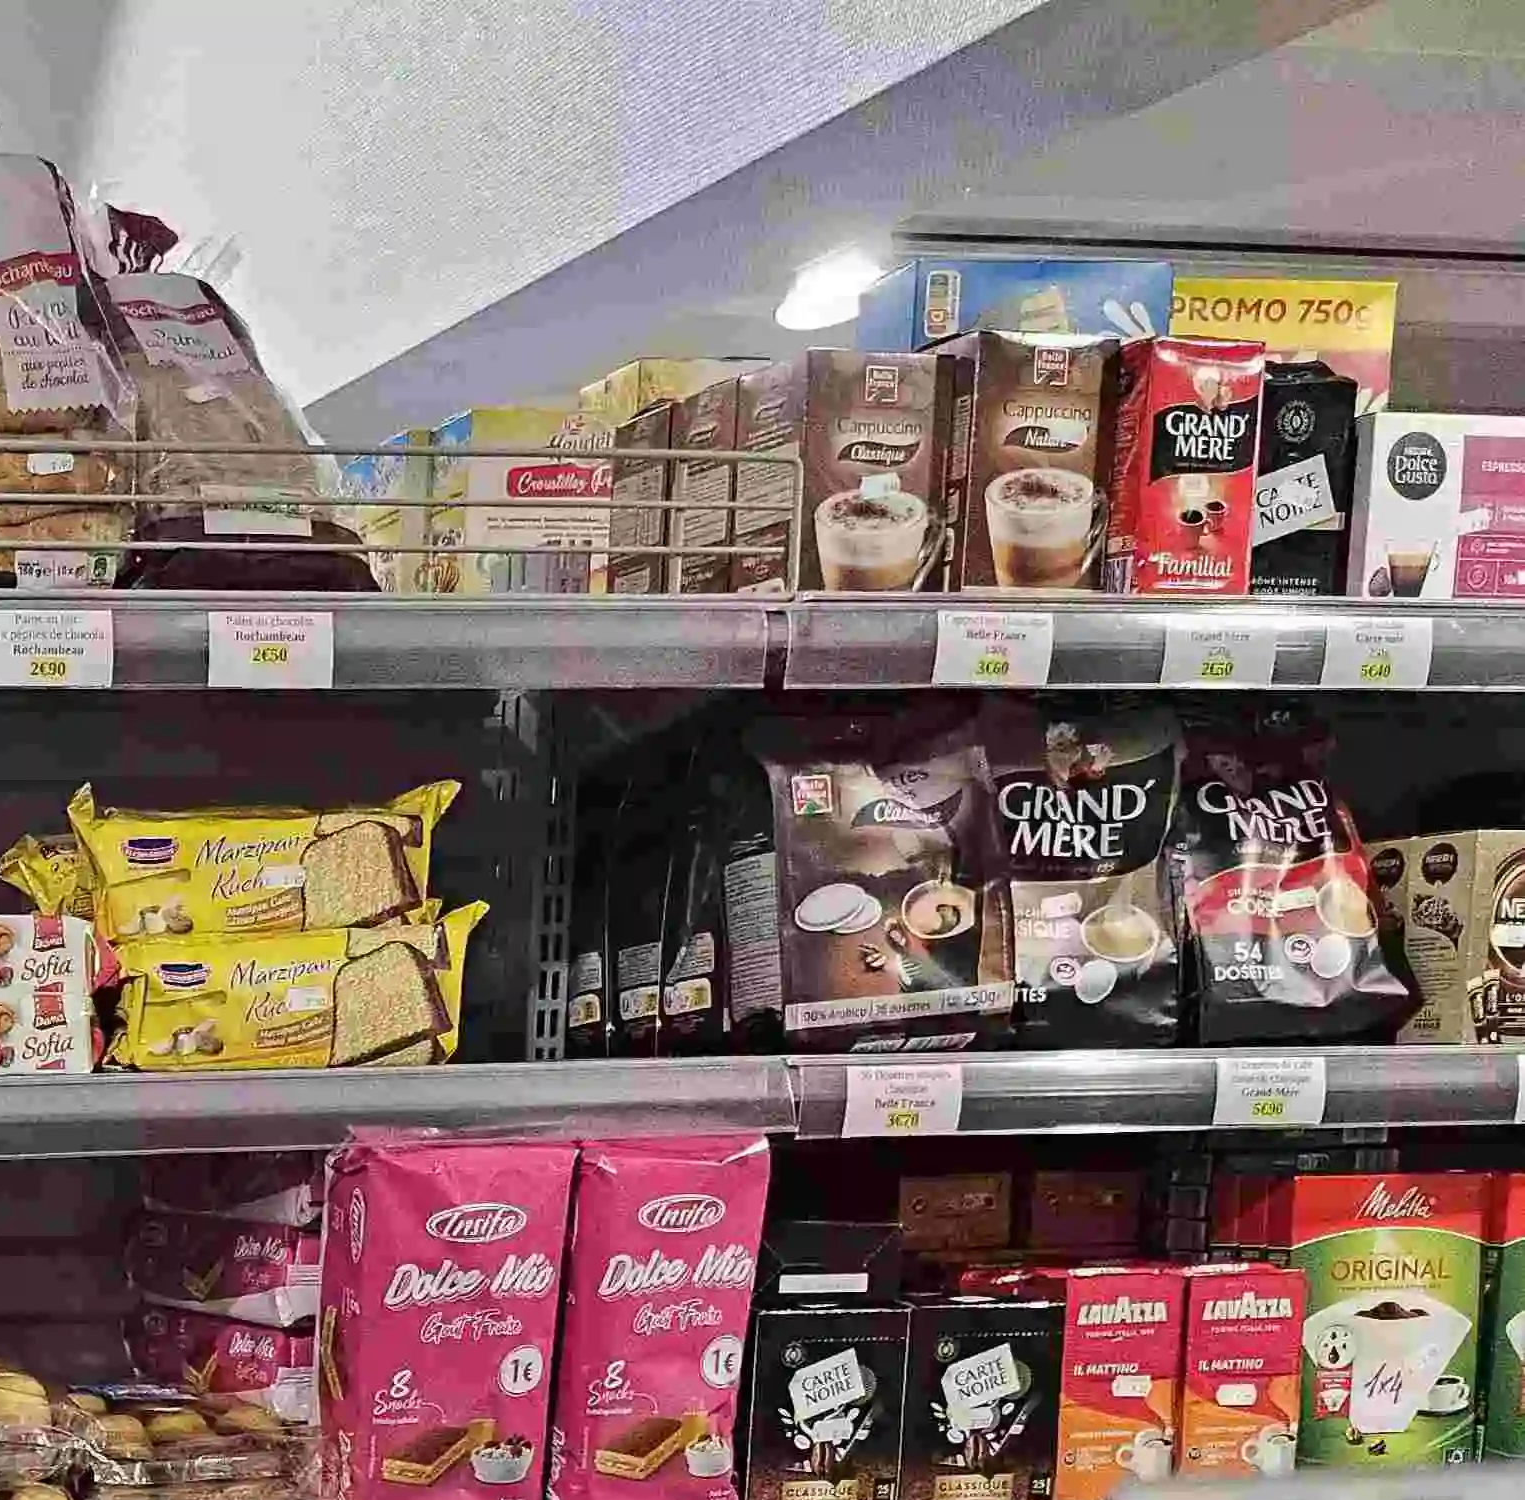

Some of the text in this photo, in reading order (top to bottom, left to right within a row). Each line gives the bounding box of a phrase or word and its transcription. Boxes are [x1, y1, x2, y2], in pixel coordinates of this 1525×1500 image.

[1170, 296, 1286, 323] PROMO
[1002, 400, 1092, 424] Cappuccino
[837, 417, 923, 439] Cappuccino
[851, 444, 906, 467] Classique
[1394, 455, 1440, 474] Dolce
[1394, 468, 1439, 487] Gusto
[1157, 552, 1233, 577] Familial
[13, 644, 84, 657] Rochambeau
[235, 631, 306, 643] Rochambeau
[252, 647, 287, 663] 2€50
[30, 662, 66, 677] 2€90
[1233, 941, 1263, 965] 54
[20, 954, 75, 984] Sofia
[21, 1034, 75, 1064] Sofia
[1355, 1181, 1433, 1221] Melitta
[384, 1253, 558, 1310] Dolce Mio
[599, 1245, 755, 1299] Dolce Mio
[1330, 1257, 1451, 1283] ORIGINAL
[1077, 1297, 1169, 1326] LAVAZZA
[1201, 1291, 1293, 1322] LAVAZZA
[509, 1357, 537, 1385] 1€
[800, 1362, 852, 1392] CARTE
[954, 1356, 1007, 1388] CARTE
[1088, 1362, 1139, 1376] MATTINO
[390, 1370, 413, 1398] 8
[804, 1378, 855, 1407] NOIRE
[958, 1374, 1010, 1402] NOIRE
[373, 1390, 423, 1418] Snacks
[784, 1484, 854, 1499] CLASSIQUE
